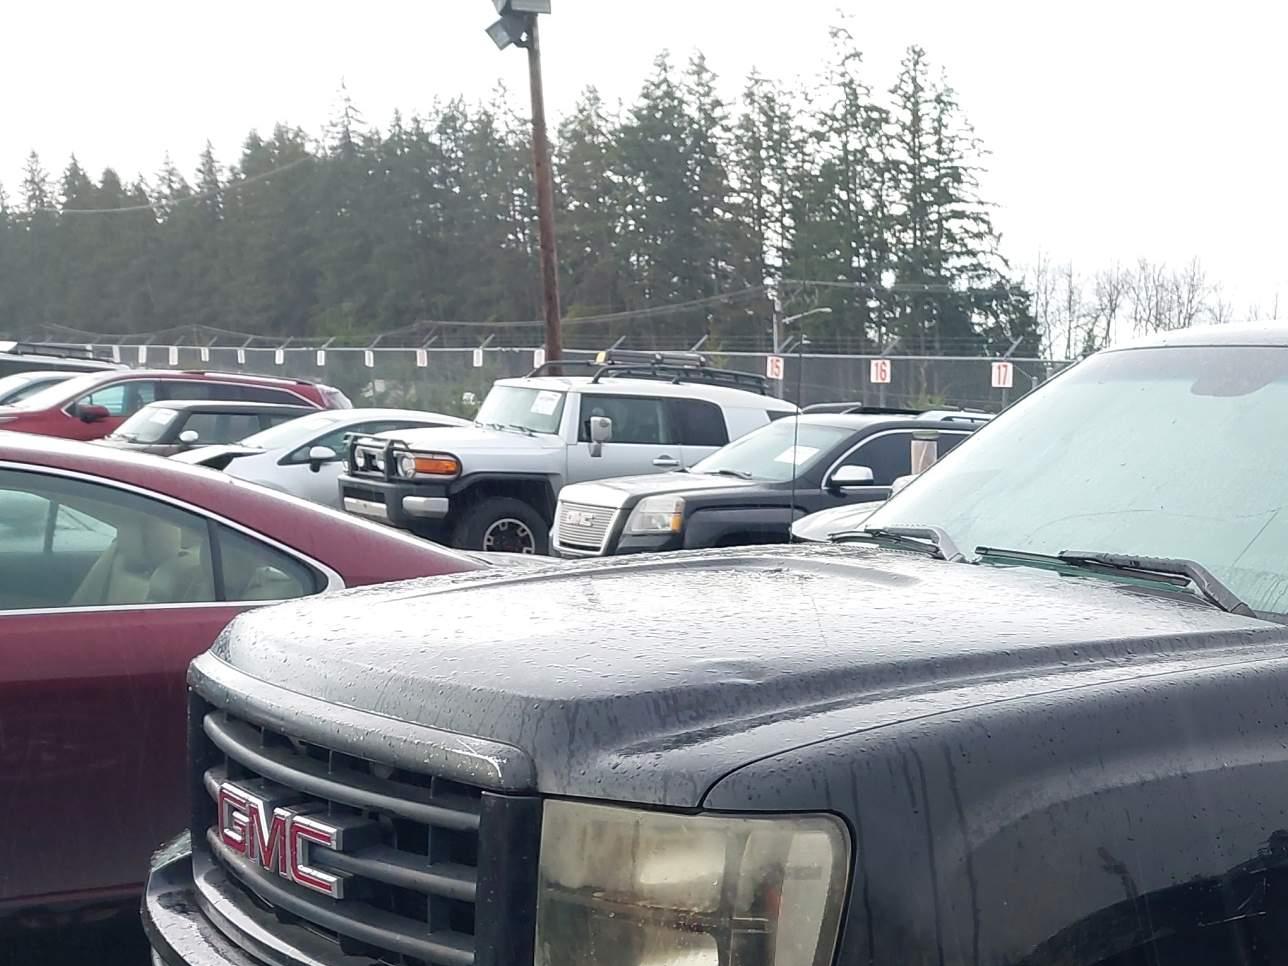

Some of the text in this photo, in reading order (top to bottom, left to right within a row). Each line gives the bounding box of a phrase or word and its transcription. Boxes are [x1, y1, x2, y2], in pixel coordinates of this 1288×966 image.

[769, 358, 782, 377] 15
[873, 362, 888, 382] 16
[996, 364, 1009, 386] 17
[218, 782, 345, 900] GMC
